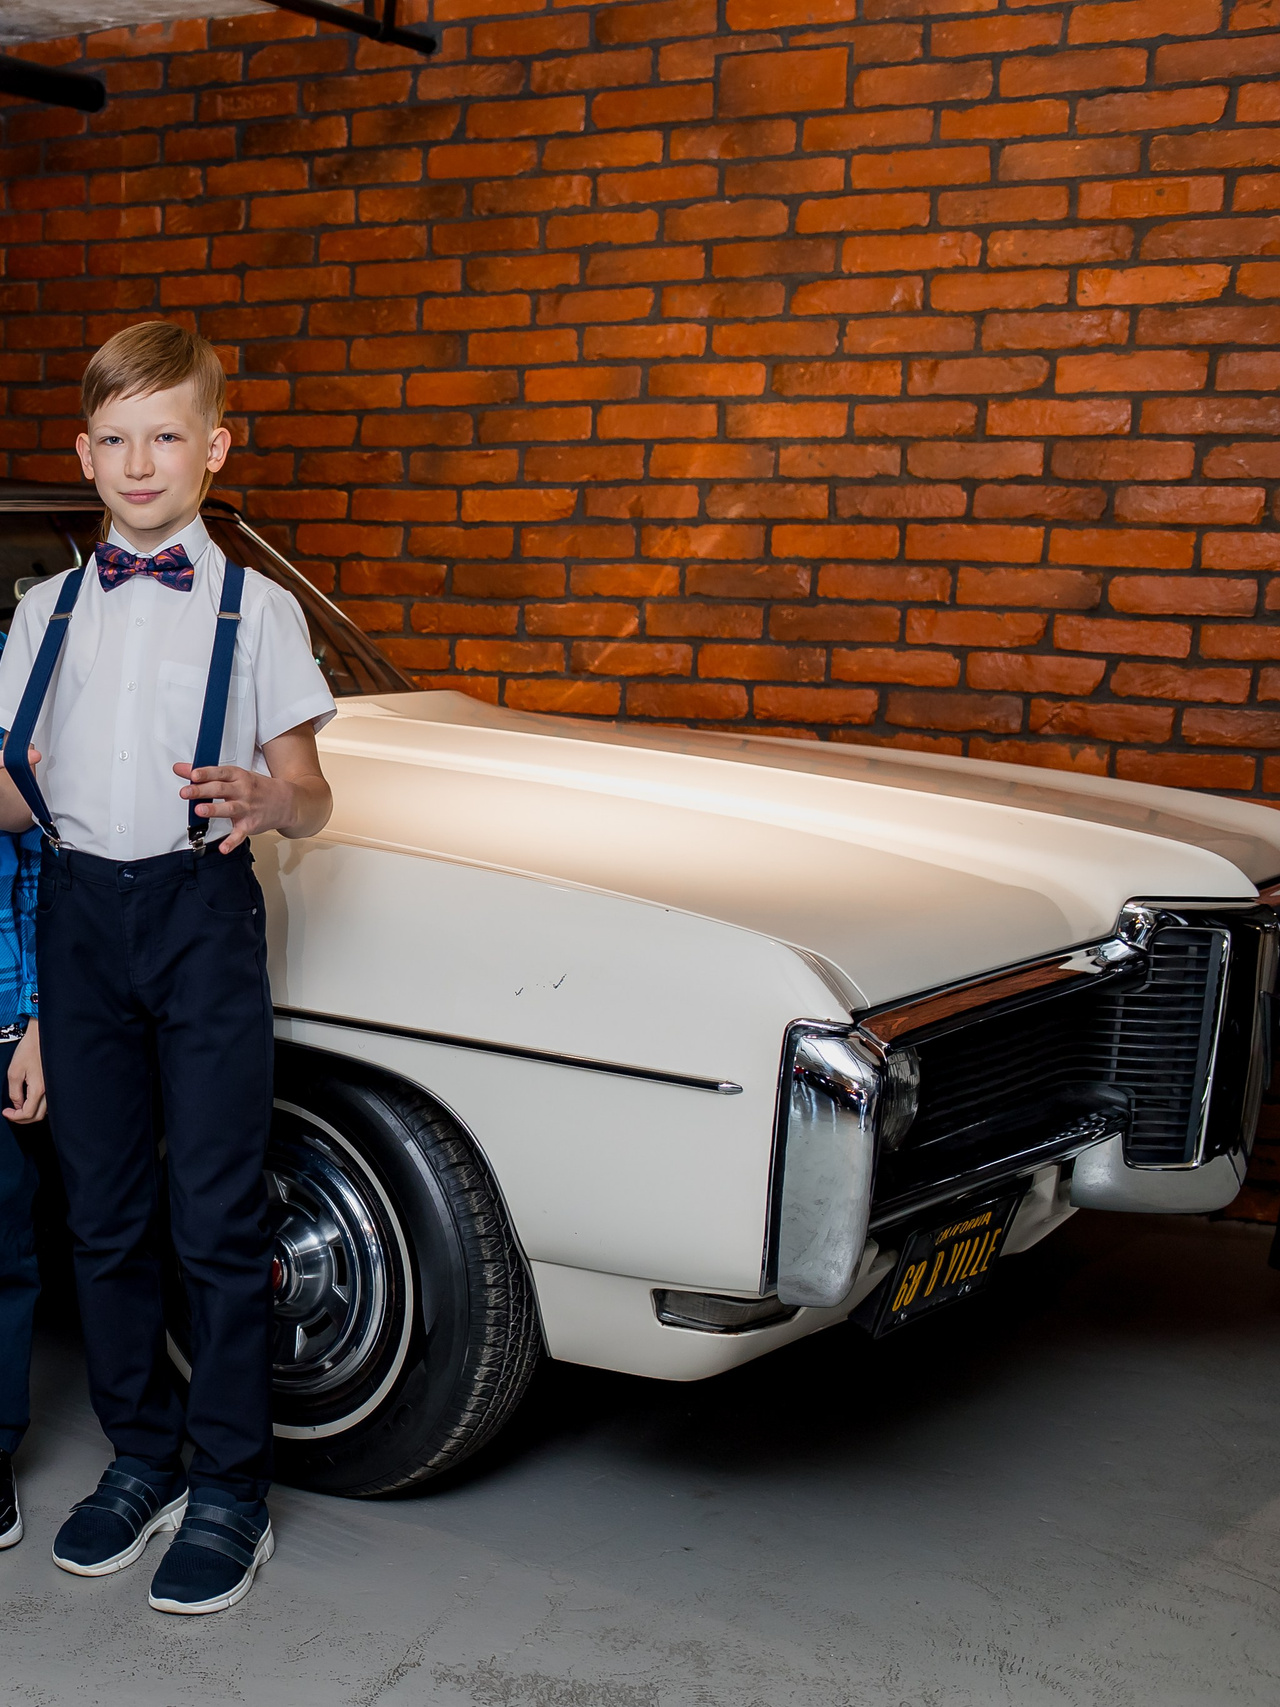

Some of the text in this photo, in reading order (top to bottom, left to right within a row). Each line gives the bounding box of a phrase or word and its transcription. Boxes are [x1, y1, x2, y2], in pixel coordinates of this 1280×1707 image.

[935, 1211, 993, 1245] CALIFORNIA
[891, 1228, 1002, 1312] 68 B VILLE
